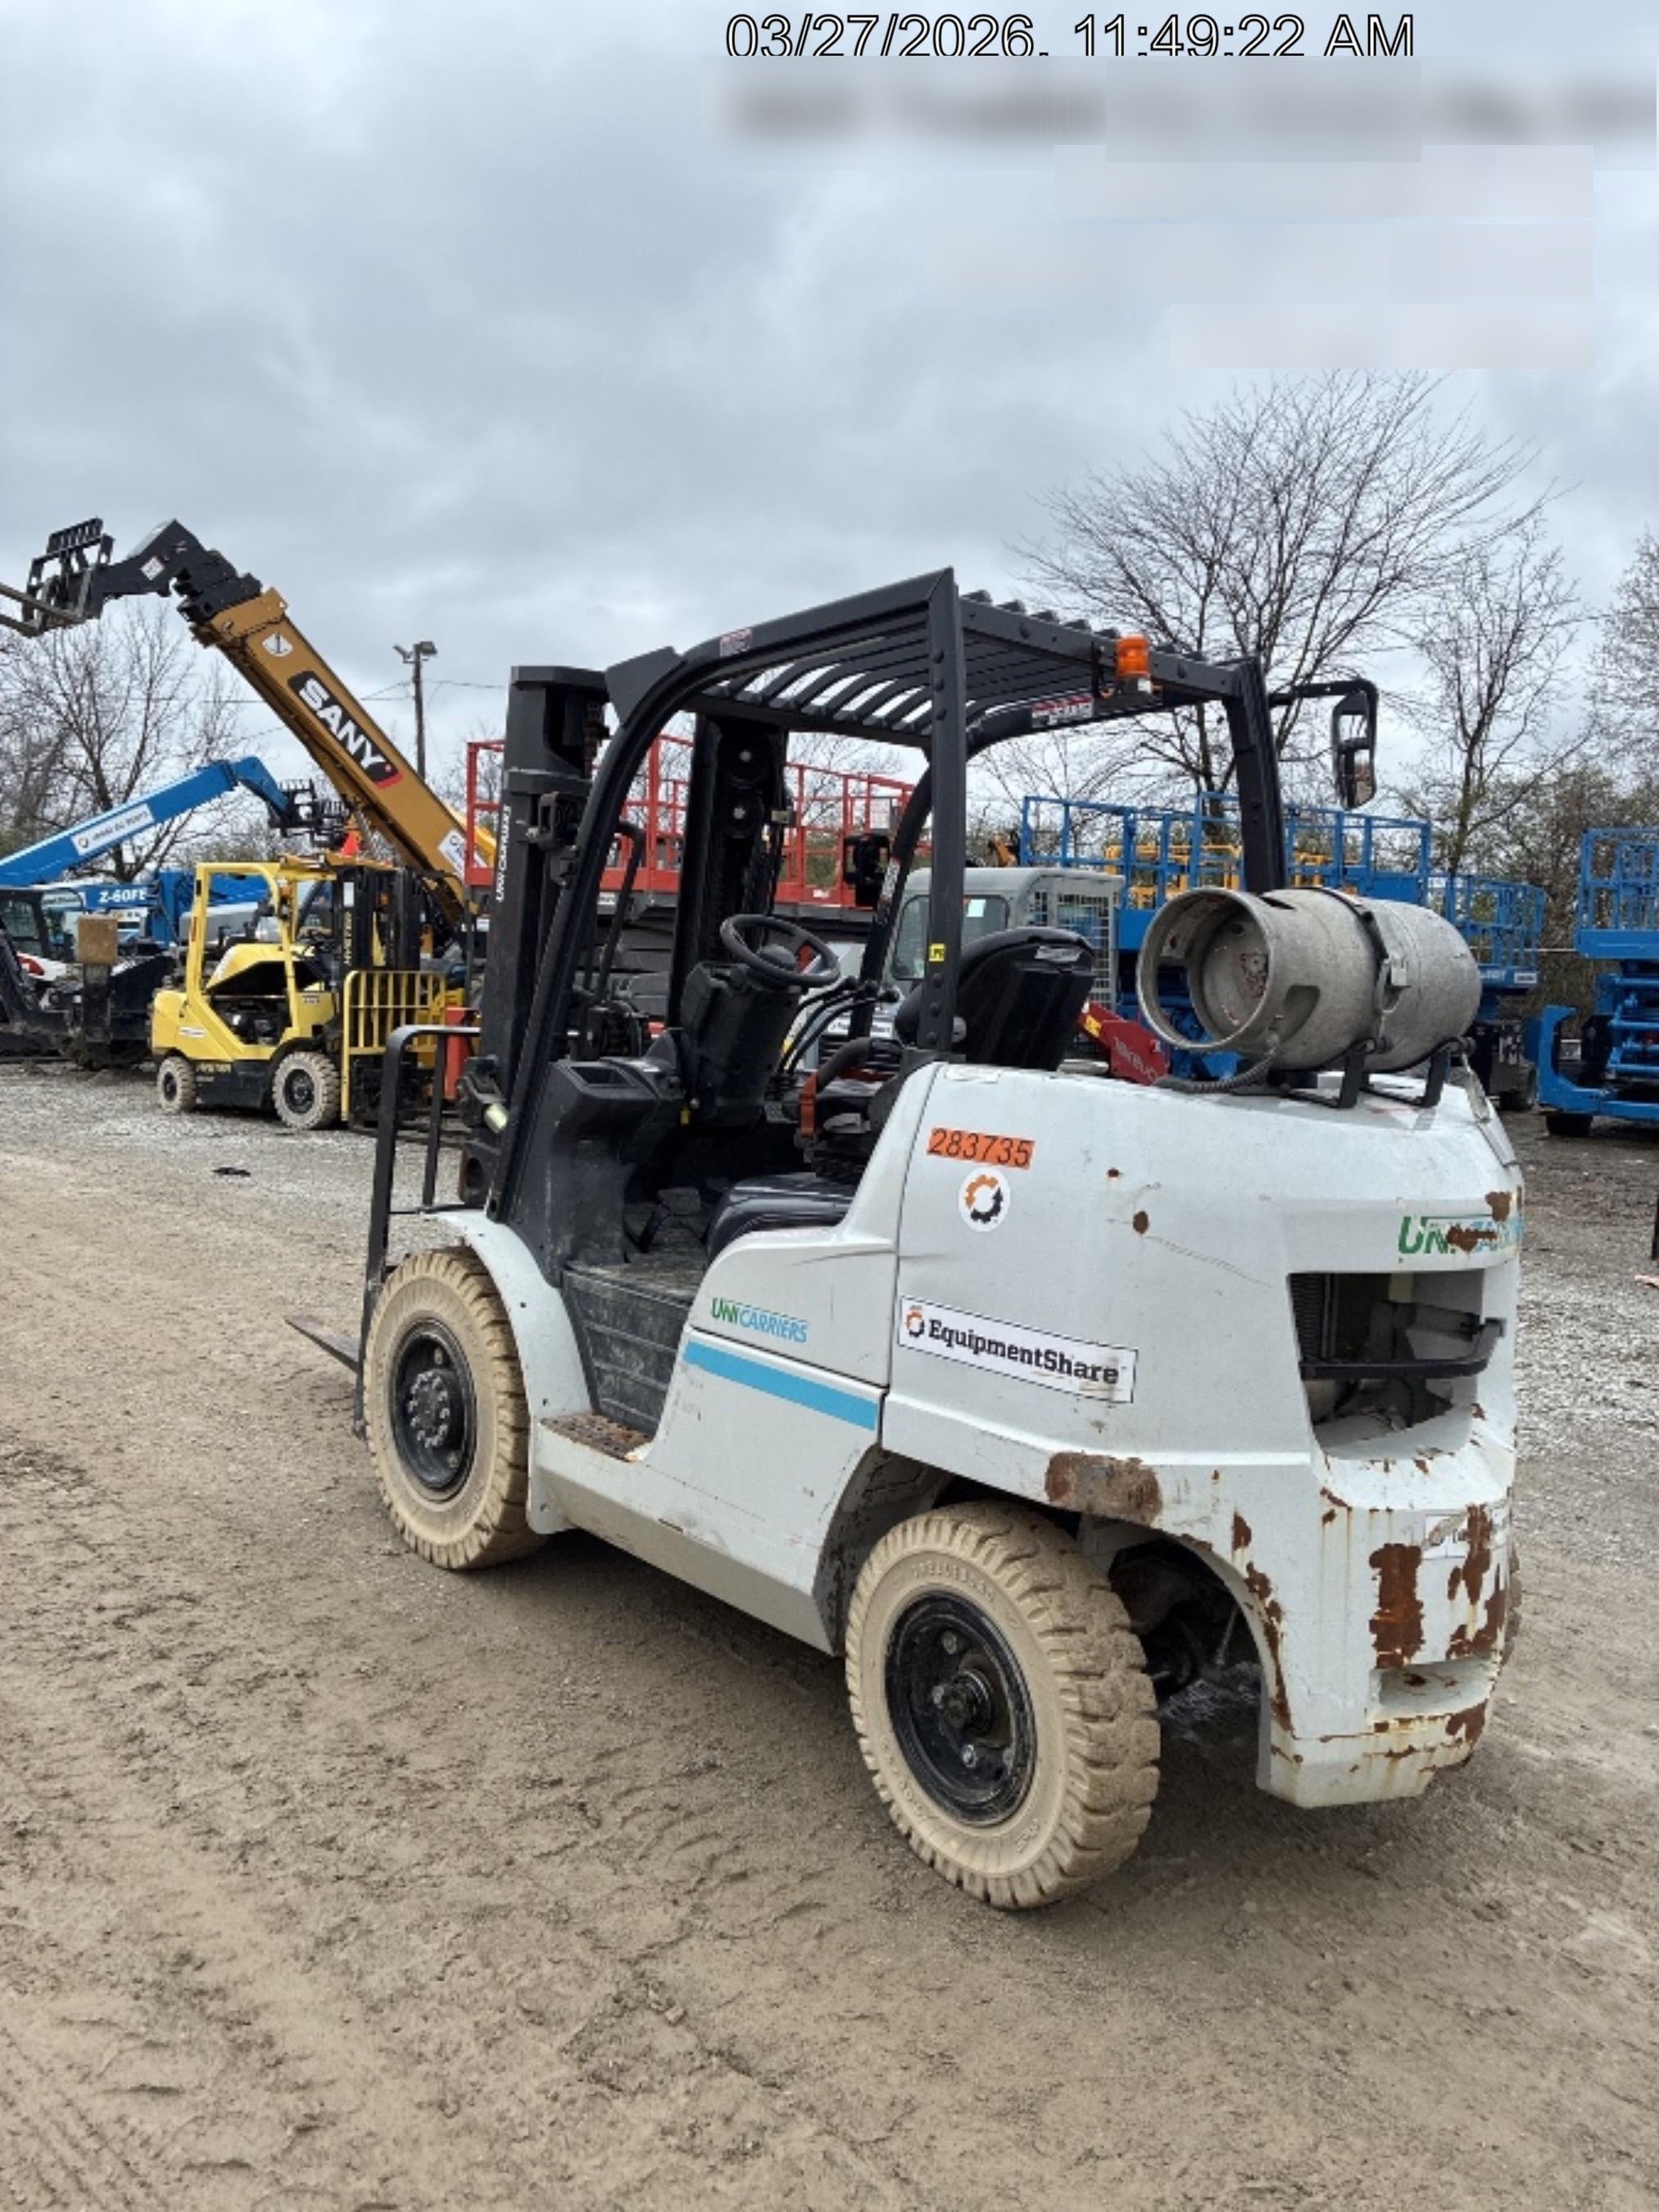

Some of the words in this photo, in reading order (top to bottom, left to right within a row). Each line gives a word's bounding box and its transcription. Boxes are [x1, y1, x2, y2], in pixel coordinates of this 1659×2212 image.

[299, 678, 387, 769] SANY
[927, 1128, 1036, 1168] 283735
[711, 1298, 808, 1343] UNICARRIERS
[928, 1318, 1119, 1385] EquipmentShare
